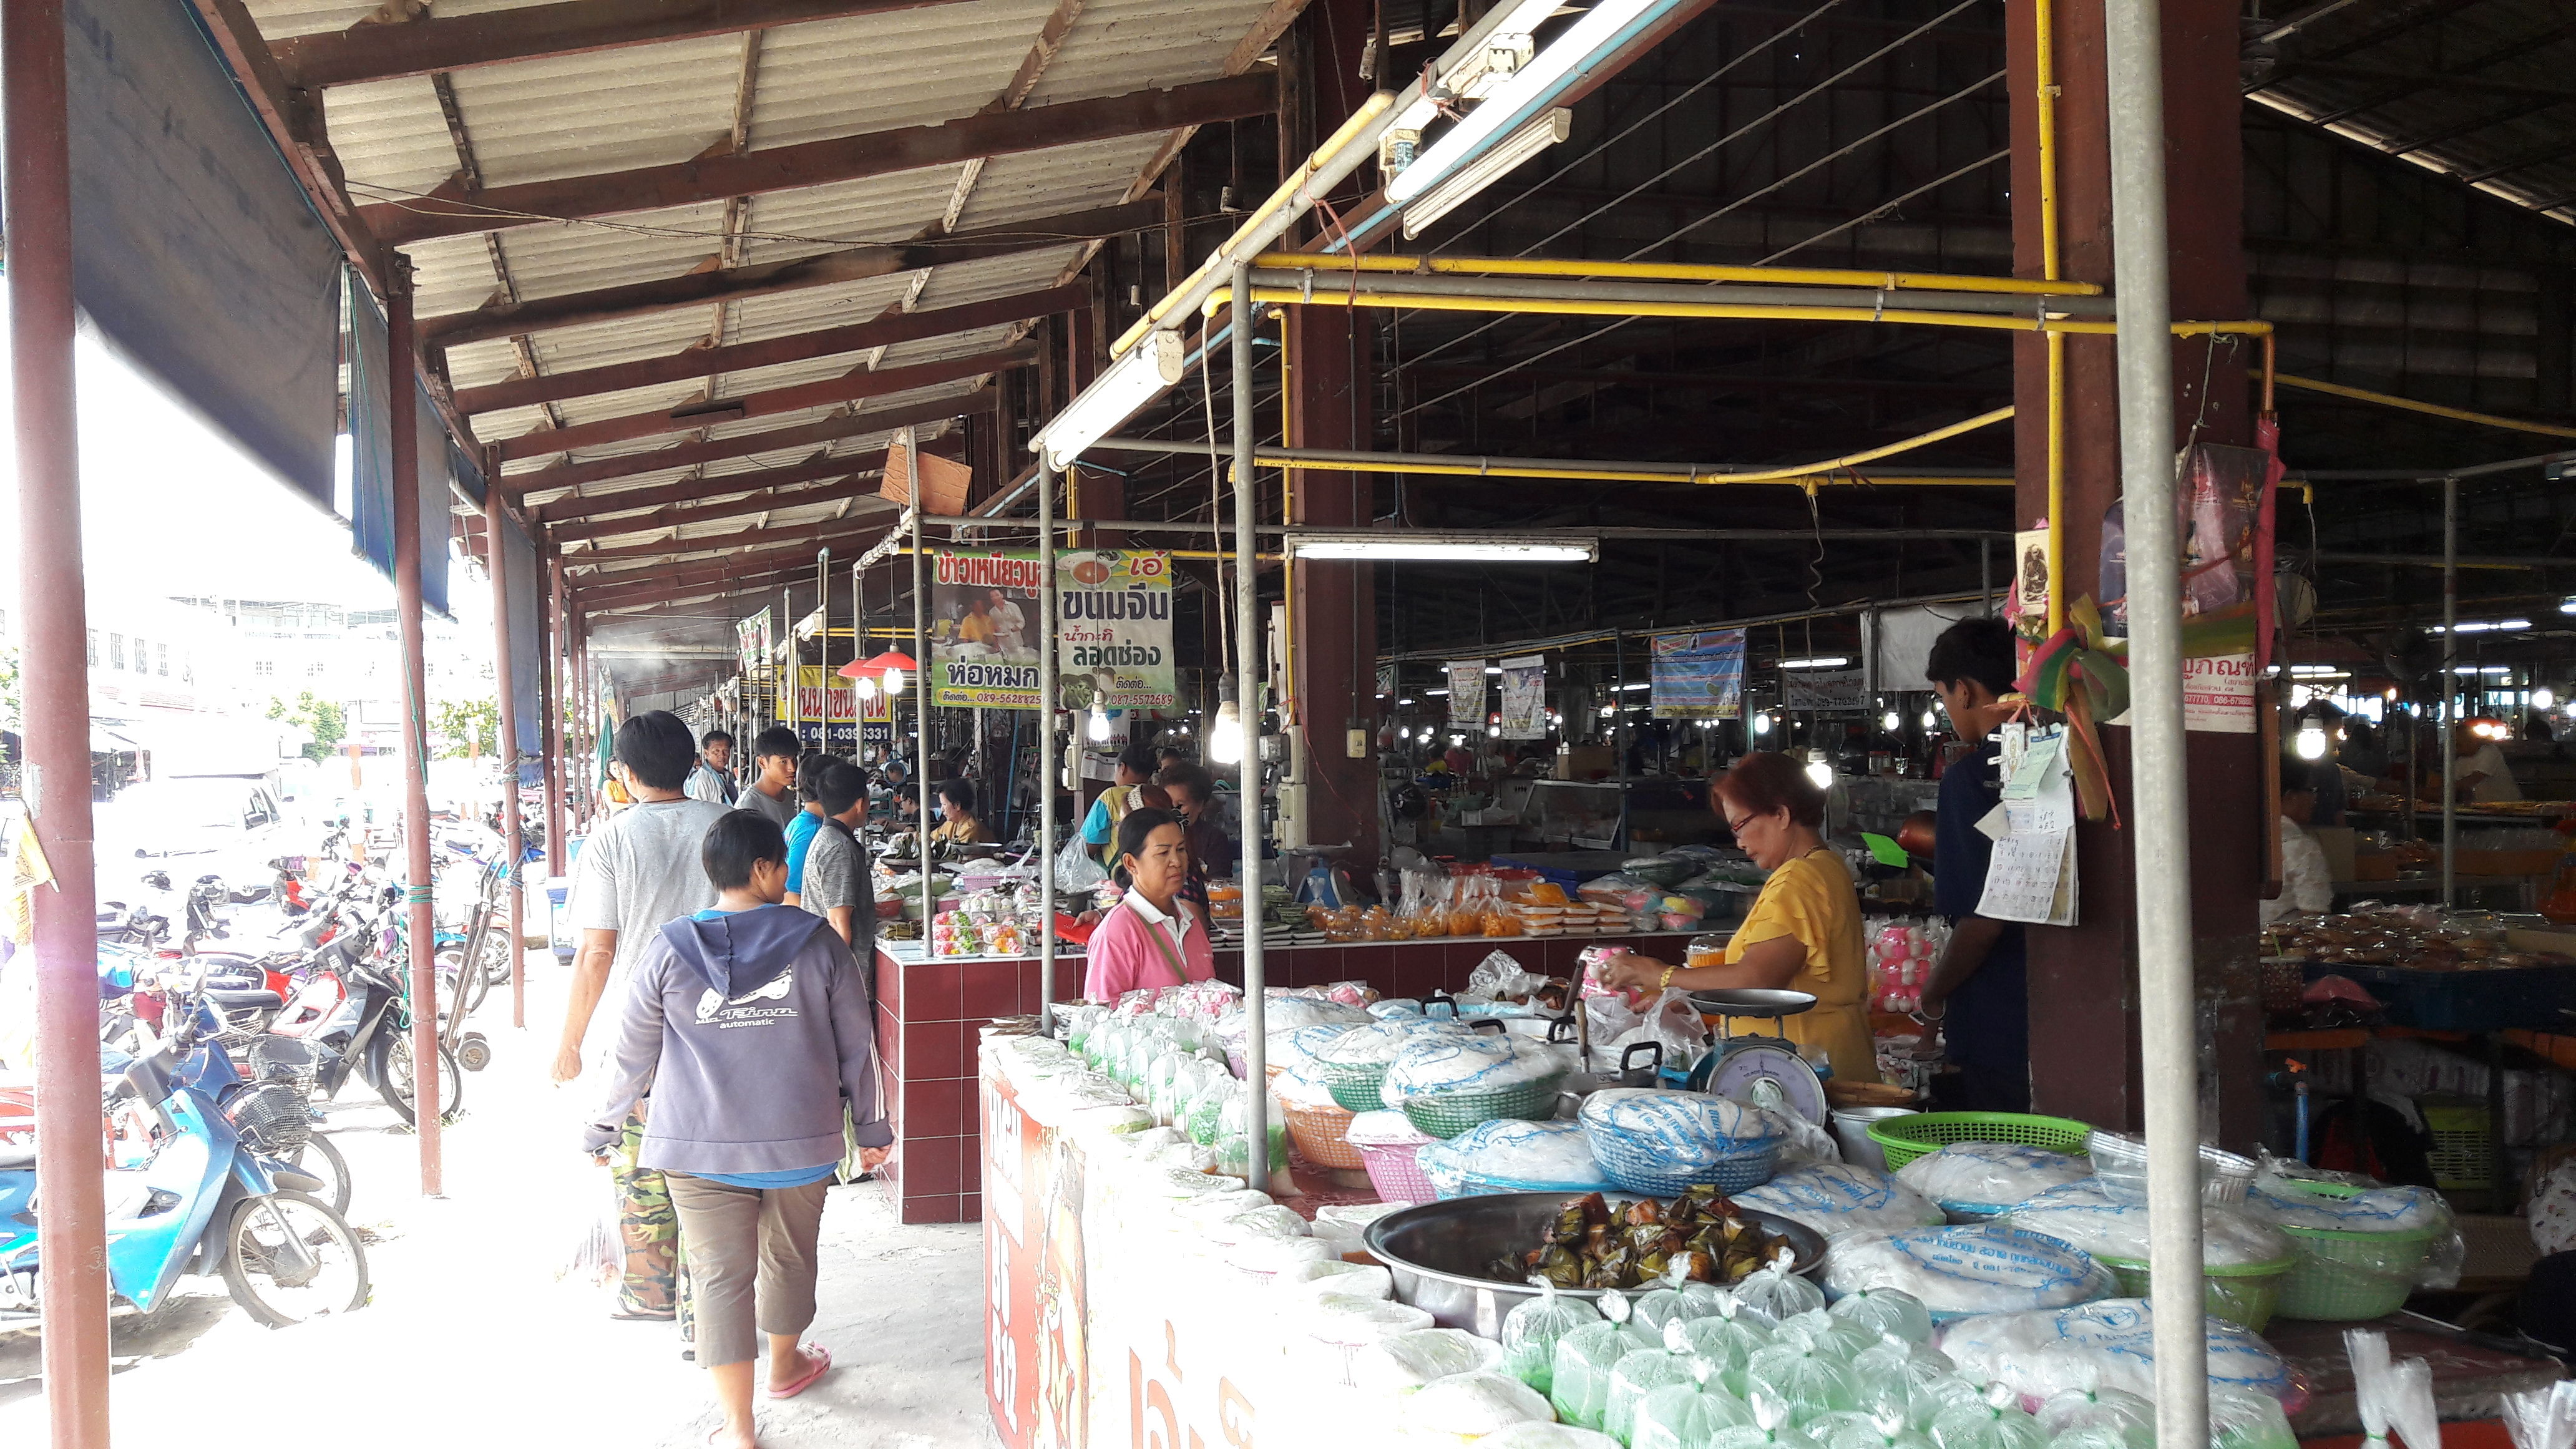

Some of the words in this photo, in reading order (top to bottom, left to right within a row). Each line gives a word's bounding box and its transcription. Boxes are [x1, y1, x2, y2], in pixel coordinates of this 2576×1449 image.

[938, 549, 1041, 598] ข้าวเหนียวมู
[1063, 582, 1168, 620] ขนมจีน
[1064, 625, 1114, 642] น้ำกะทิ
[1073, 639, 1161, 666] ลอดช่อง
[947, 655, 1039, 688] ห่อหมก
[977, 693, 1042, 705] 089-5628825
[1111, 694, 1174, 705] 087-5572689
[720, 1018, 776, 1029] automatic
